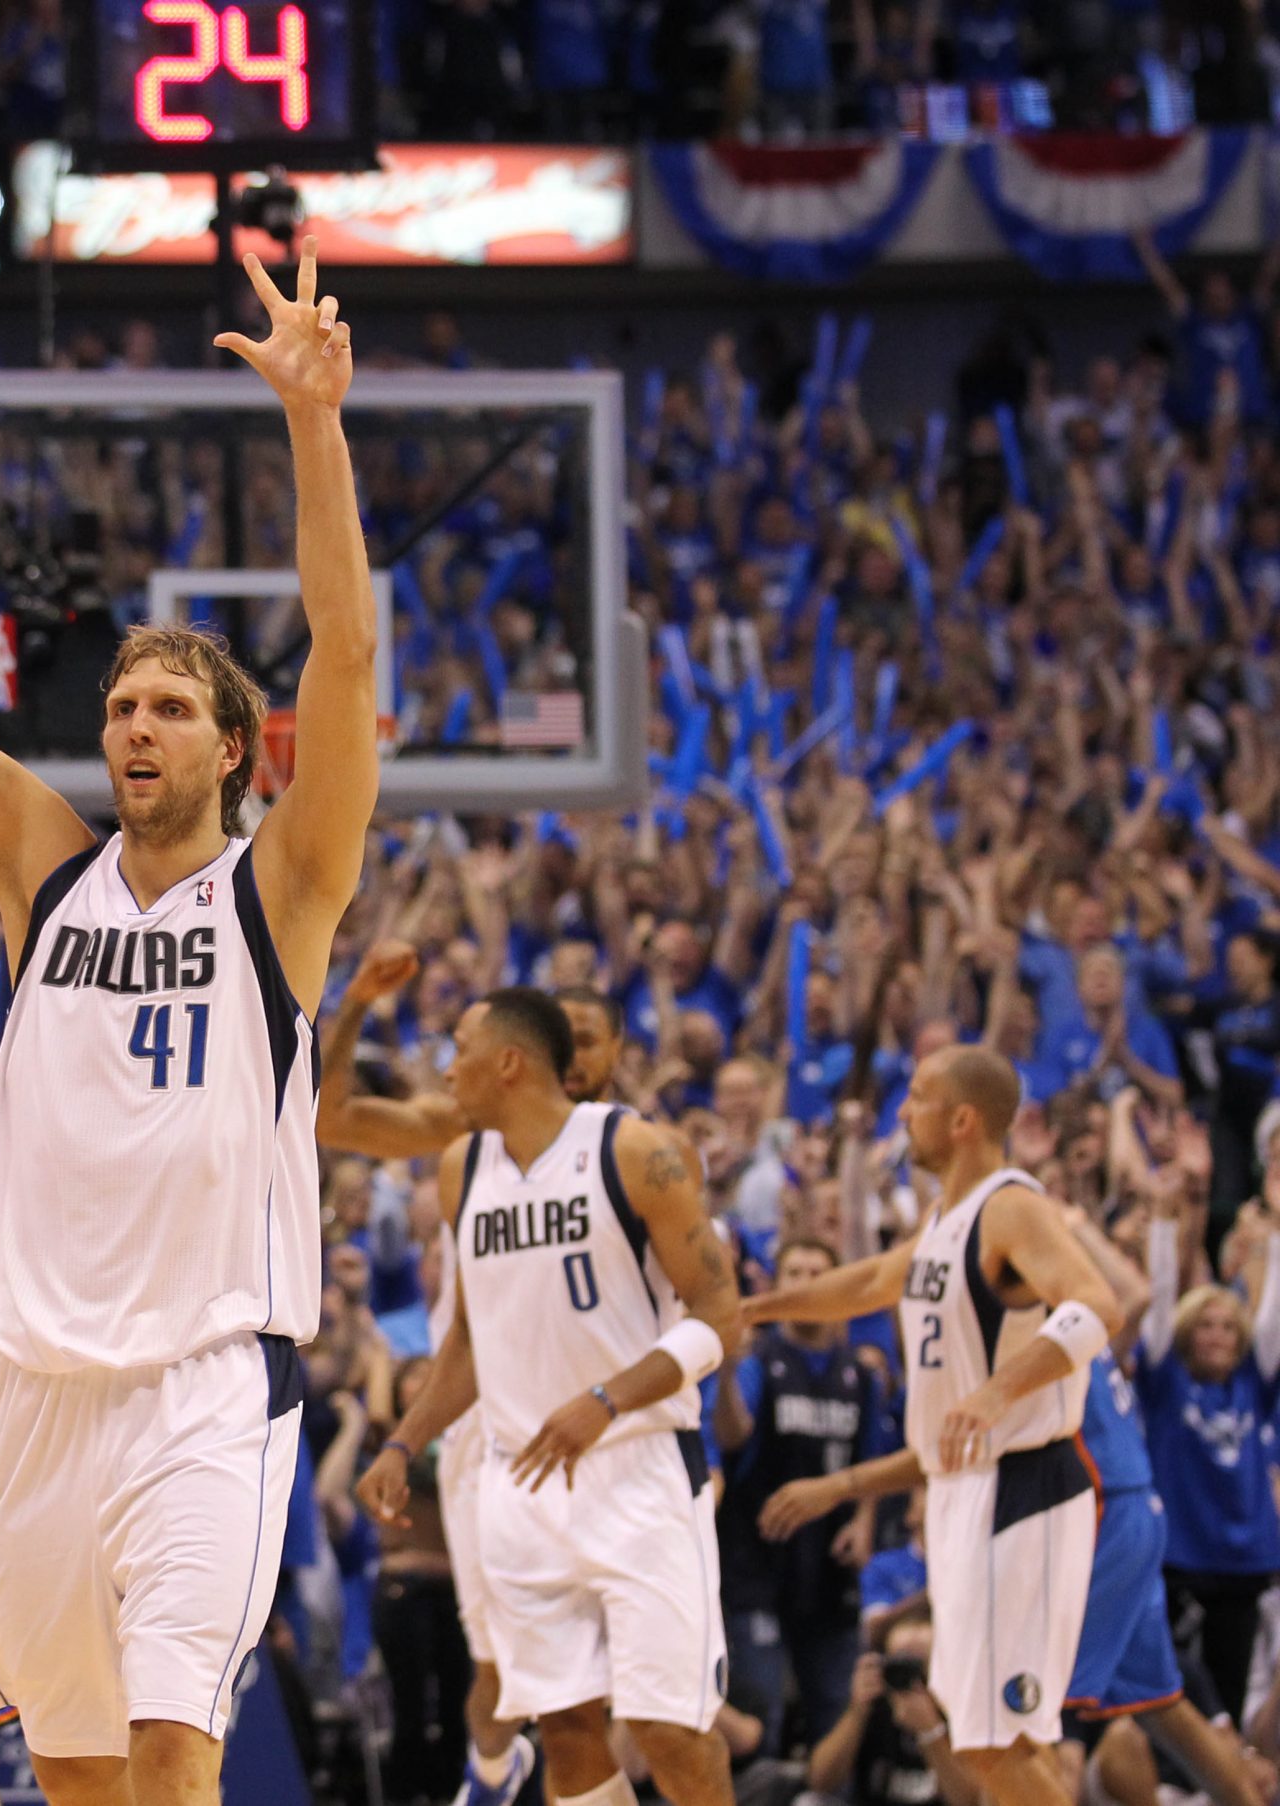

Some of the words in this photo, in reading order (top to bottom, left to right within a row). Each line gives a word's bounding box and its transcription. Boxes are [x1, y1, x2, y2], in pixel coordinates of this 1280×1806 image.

[134, 0, 309, 142] 24
[40, 924, 217, 996] DALLAS
[126, 1002, 212, 1090] 41
[473, 1195, 590, 1259] DALLAS
[562, 1251, 600, 1312] 0
[918, 1313, 942, 1369] 2
